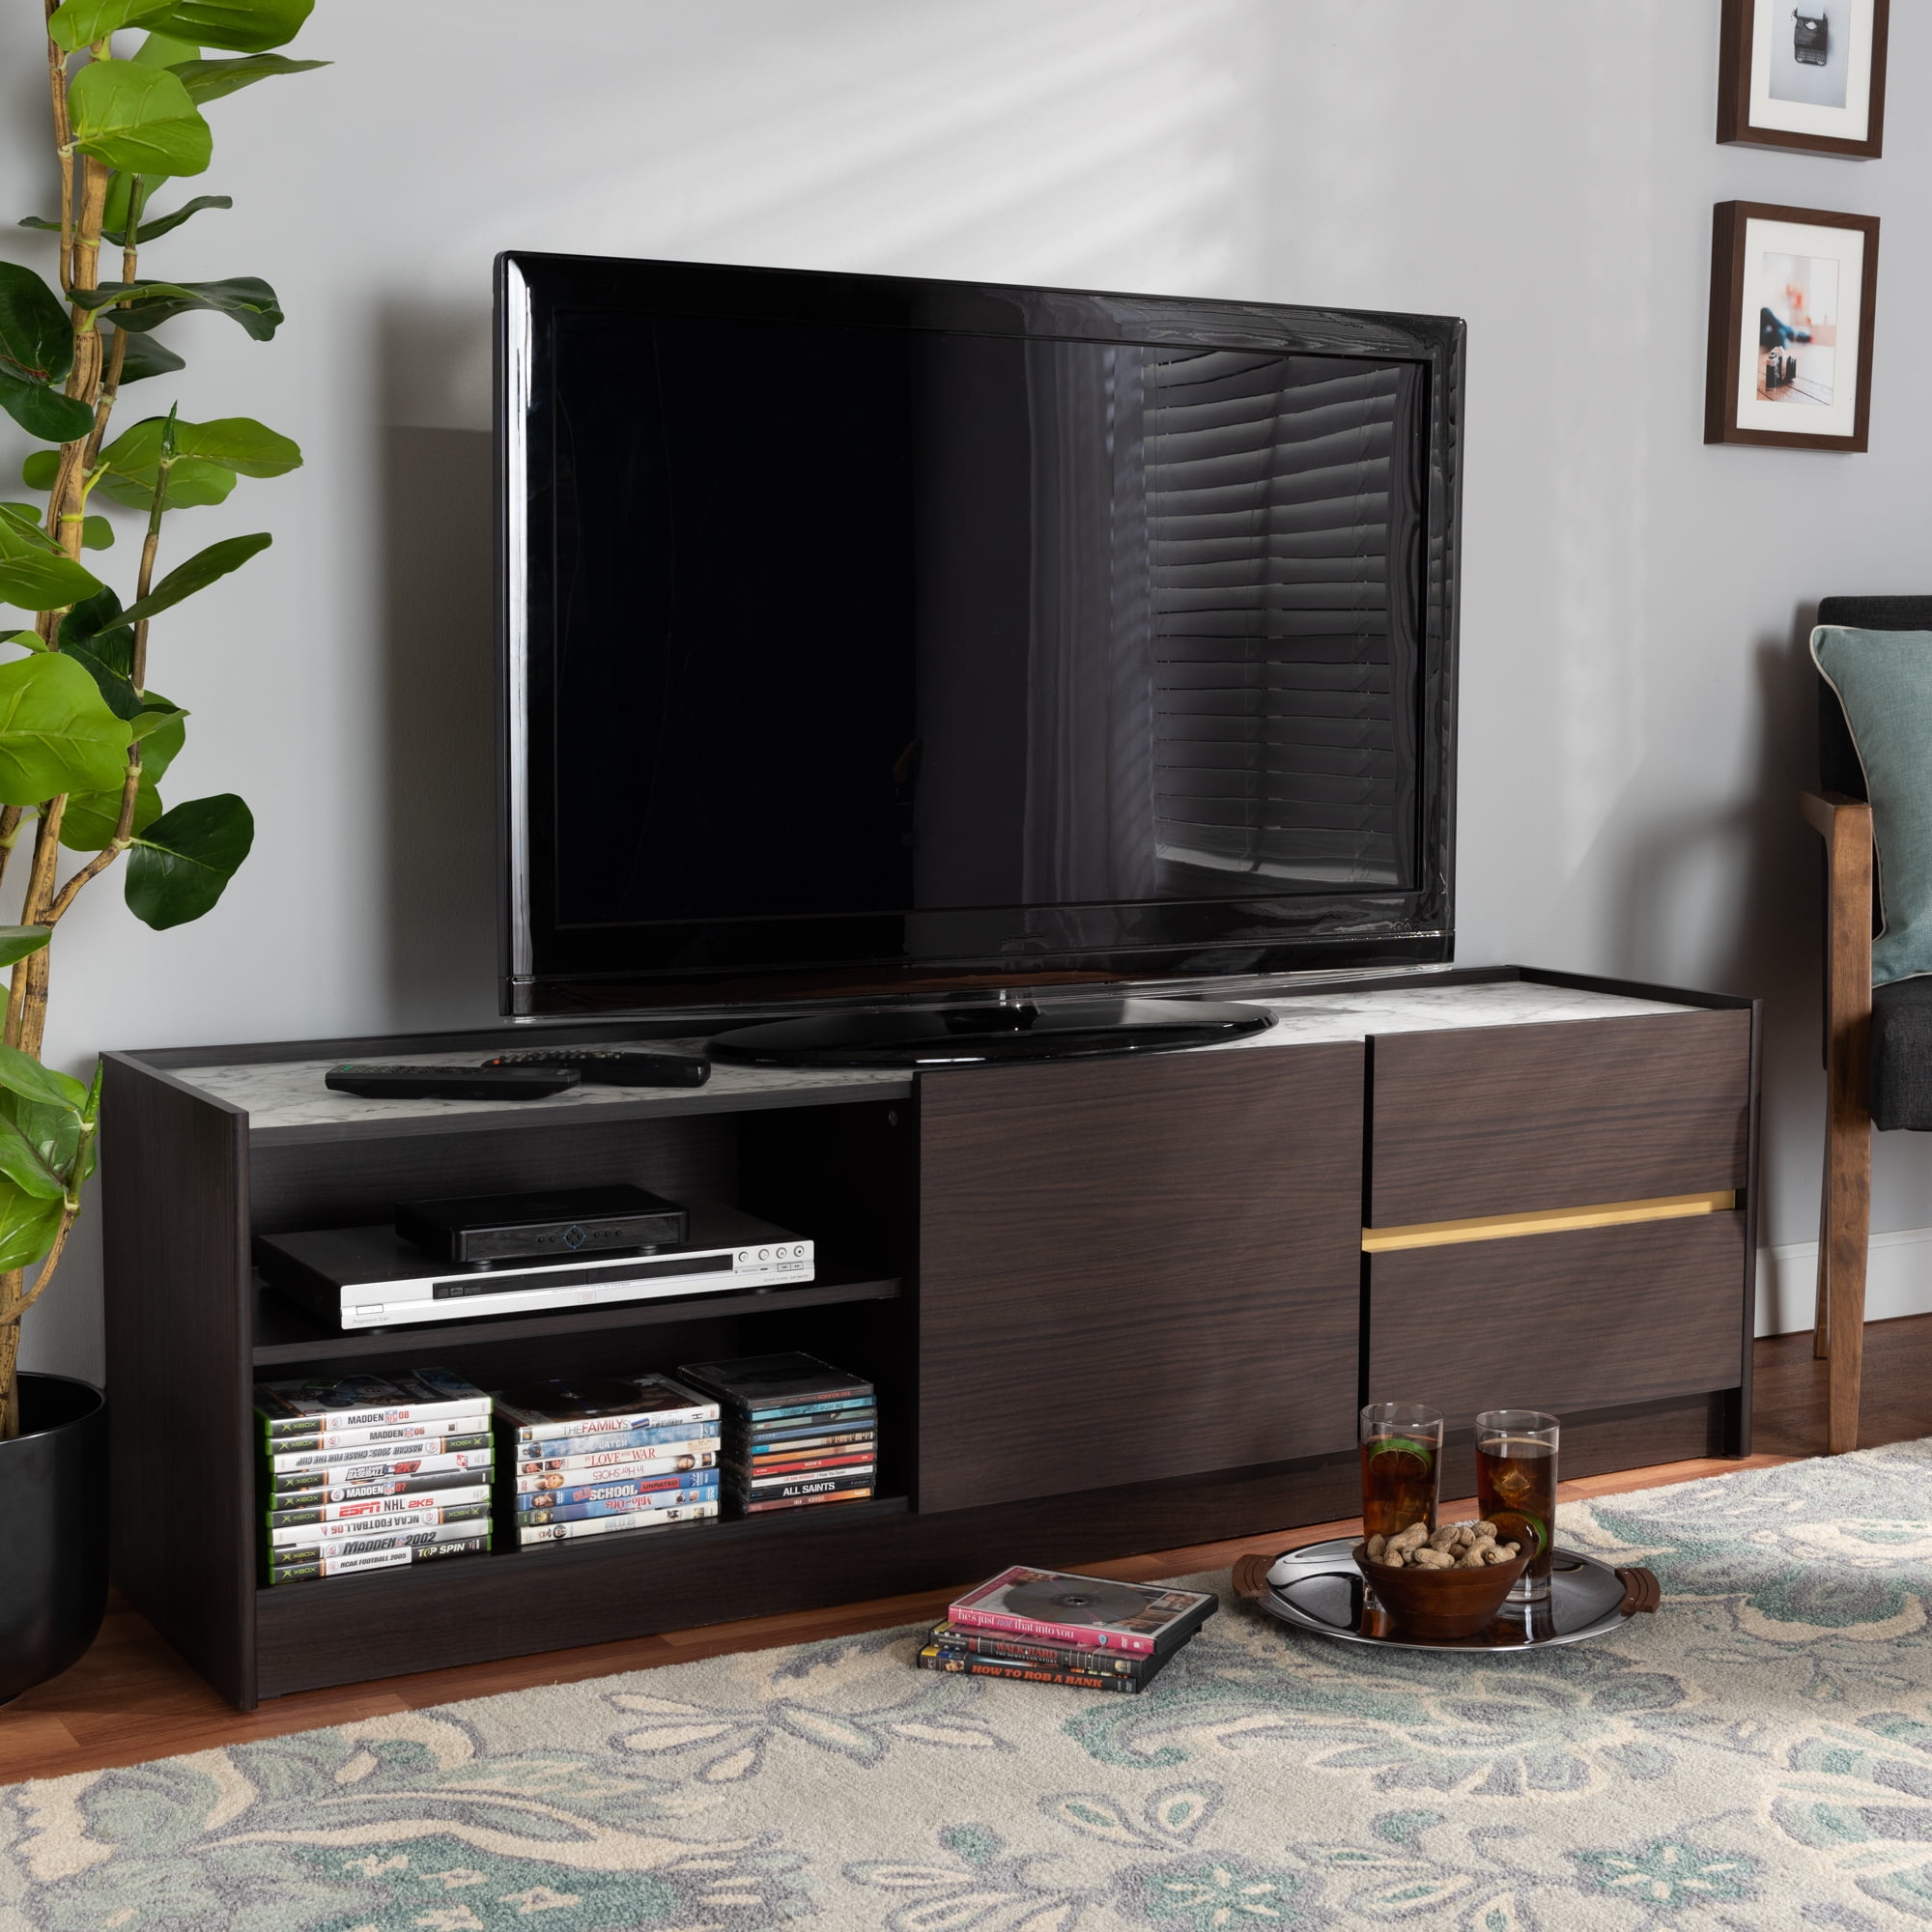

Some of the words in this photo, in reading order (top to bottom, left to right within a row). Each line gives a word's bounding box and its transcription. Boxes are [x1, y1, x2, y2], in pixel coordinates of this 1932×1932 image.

[348, 1413, 384, 1425] MADDEN
[398, 1410, 410, 1420] 08
[369, 1429, 404, 1440] MADDEN
[413, 1427, 425, 1435] 06
[563, 1425, 582, 1435] THE
[582, 1418, 623, 1434] FAMILY
[344, 1450, 367, 1461] CHASE
[393, 1443, 423, 1455] NASCAR
[296, 1457, 313, 1466] CUP
[313, 1455, 327, 1464] THE
[330, 1453, 344, 1462] FOR
[591, 1452, 620, 1466] LOVE
[632, 1447, 656, 1461] WAR
[397, 1460, 421, 1473] 2K7
[296, 1476, 319, 1485] XBOX
[592, 1467, 620, 1481] SHOES
[347, 1486, 384, 1498] MADDEN
[395, 1482, 407, 1492] 07
[642, 1479, 678, 1490] UNRATED
[782, 1487, 801, 1496] ALL
[802, 1482, 836, 1493] SAINTS
[588, 1483, 638, 1501] SCHOOL
[339, 1500, 381, 1518] ESPN
[384, 1498, 405, 1512] NHL
[408, 1498, 434, 1508] 2K5
[345, 1517, 392, 1532] FOOTBALL
[394, 1515, 419, 1524] NCAA
[331, 1524, 344, 1534] 06
[343, 1537, 397, 1555] MADDEN
[405, 1531, 438, 1546] 2002
[417, 1547, 438, 1558] TOP
[440, 1543, 466, 1554] SPIN
[340, 1560, 357, 1569] NCAA
[358, 1554, 389, 1565] FOOTBALL
[390, 1552, 407, 1561] 2005
[293, 1567, 317, 1576] XBOX
[958, 1608, 977, 1622] he's
[978, 1615, 995, 1626] just
[996, 1618, 1012, 1628] not
[1014, 1620, 1034, 1632] that
[1035, 1623, 1055, 1634] into
[1056, 1630, 1074, 1639] you
[995, 1642, 1025, 1655] WALK
[1028, 1646, 1058, 1659] HARD
[972, 1664, 1002, 1677] HOW
[1004, 1668, 1022, 1678] TO
[1024, 1671, 1052, 1682] ROB
[1053, 1674, 1063, 1684] A
[1065, 1676, 1103, 1688] BANK
